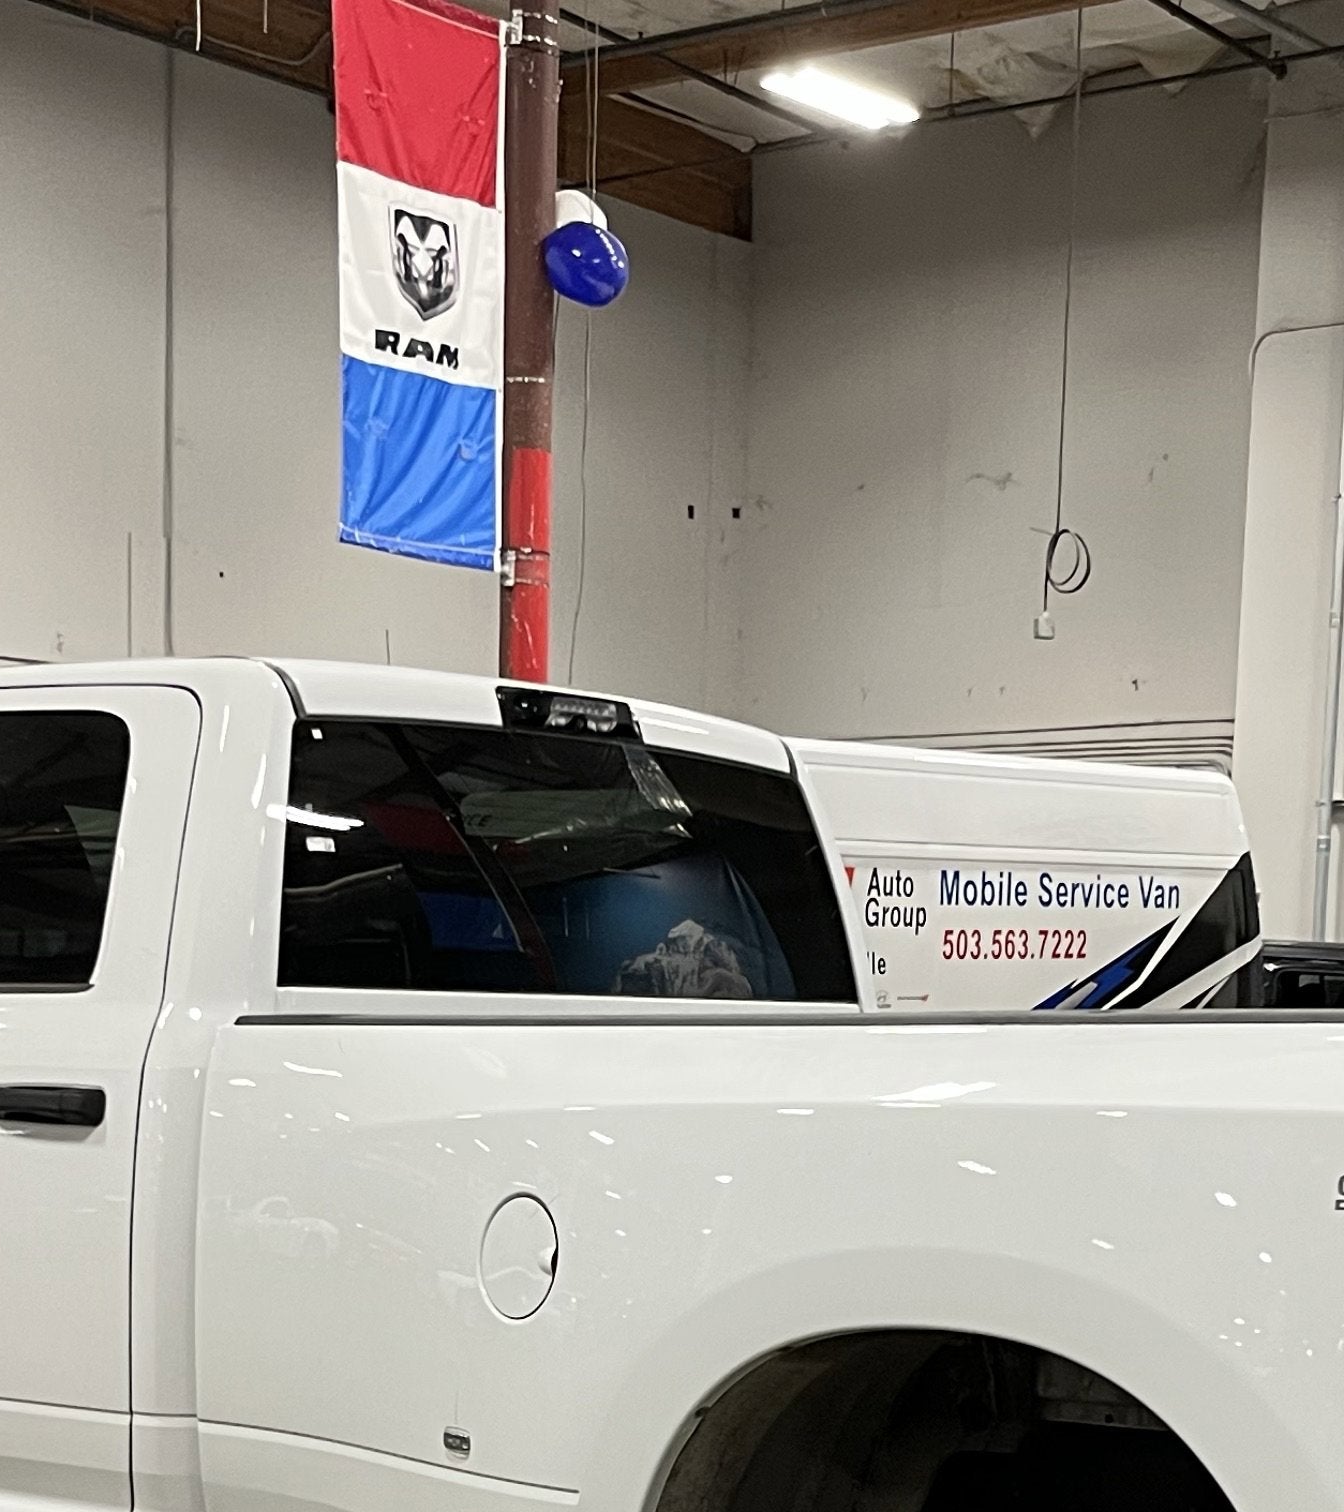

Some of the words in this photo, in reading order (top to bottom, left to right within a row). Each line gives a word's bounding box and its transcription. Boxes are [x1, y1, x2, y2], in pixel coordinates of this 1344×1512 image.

[375, 329, 459, 371] RAM
[867, 867, 914, 898] Auto
[940, 869, 1028, 907] Mobile
[1038, 872, 1130, 908] Service
[1138, 875, 1180, 909] Van
[865, 897, 927, 936] Group
[942, 929, 1087, 960] 503.563.7222
